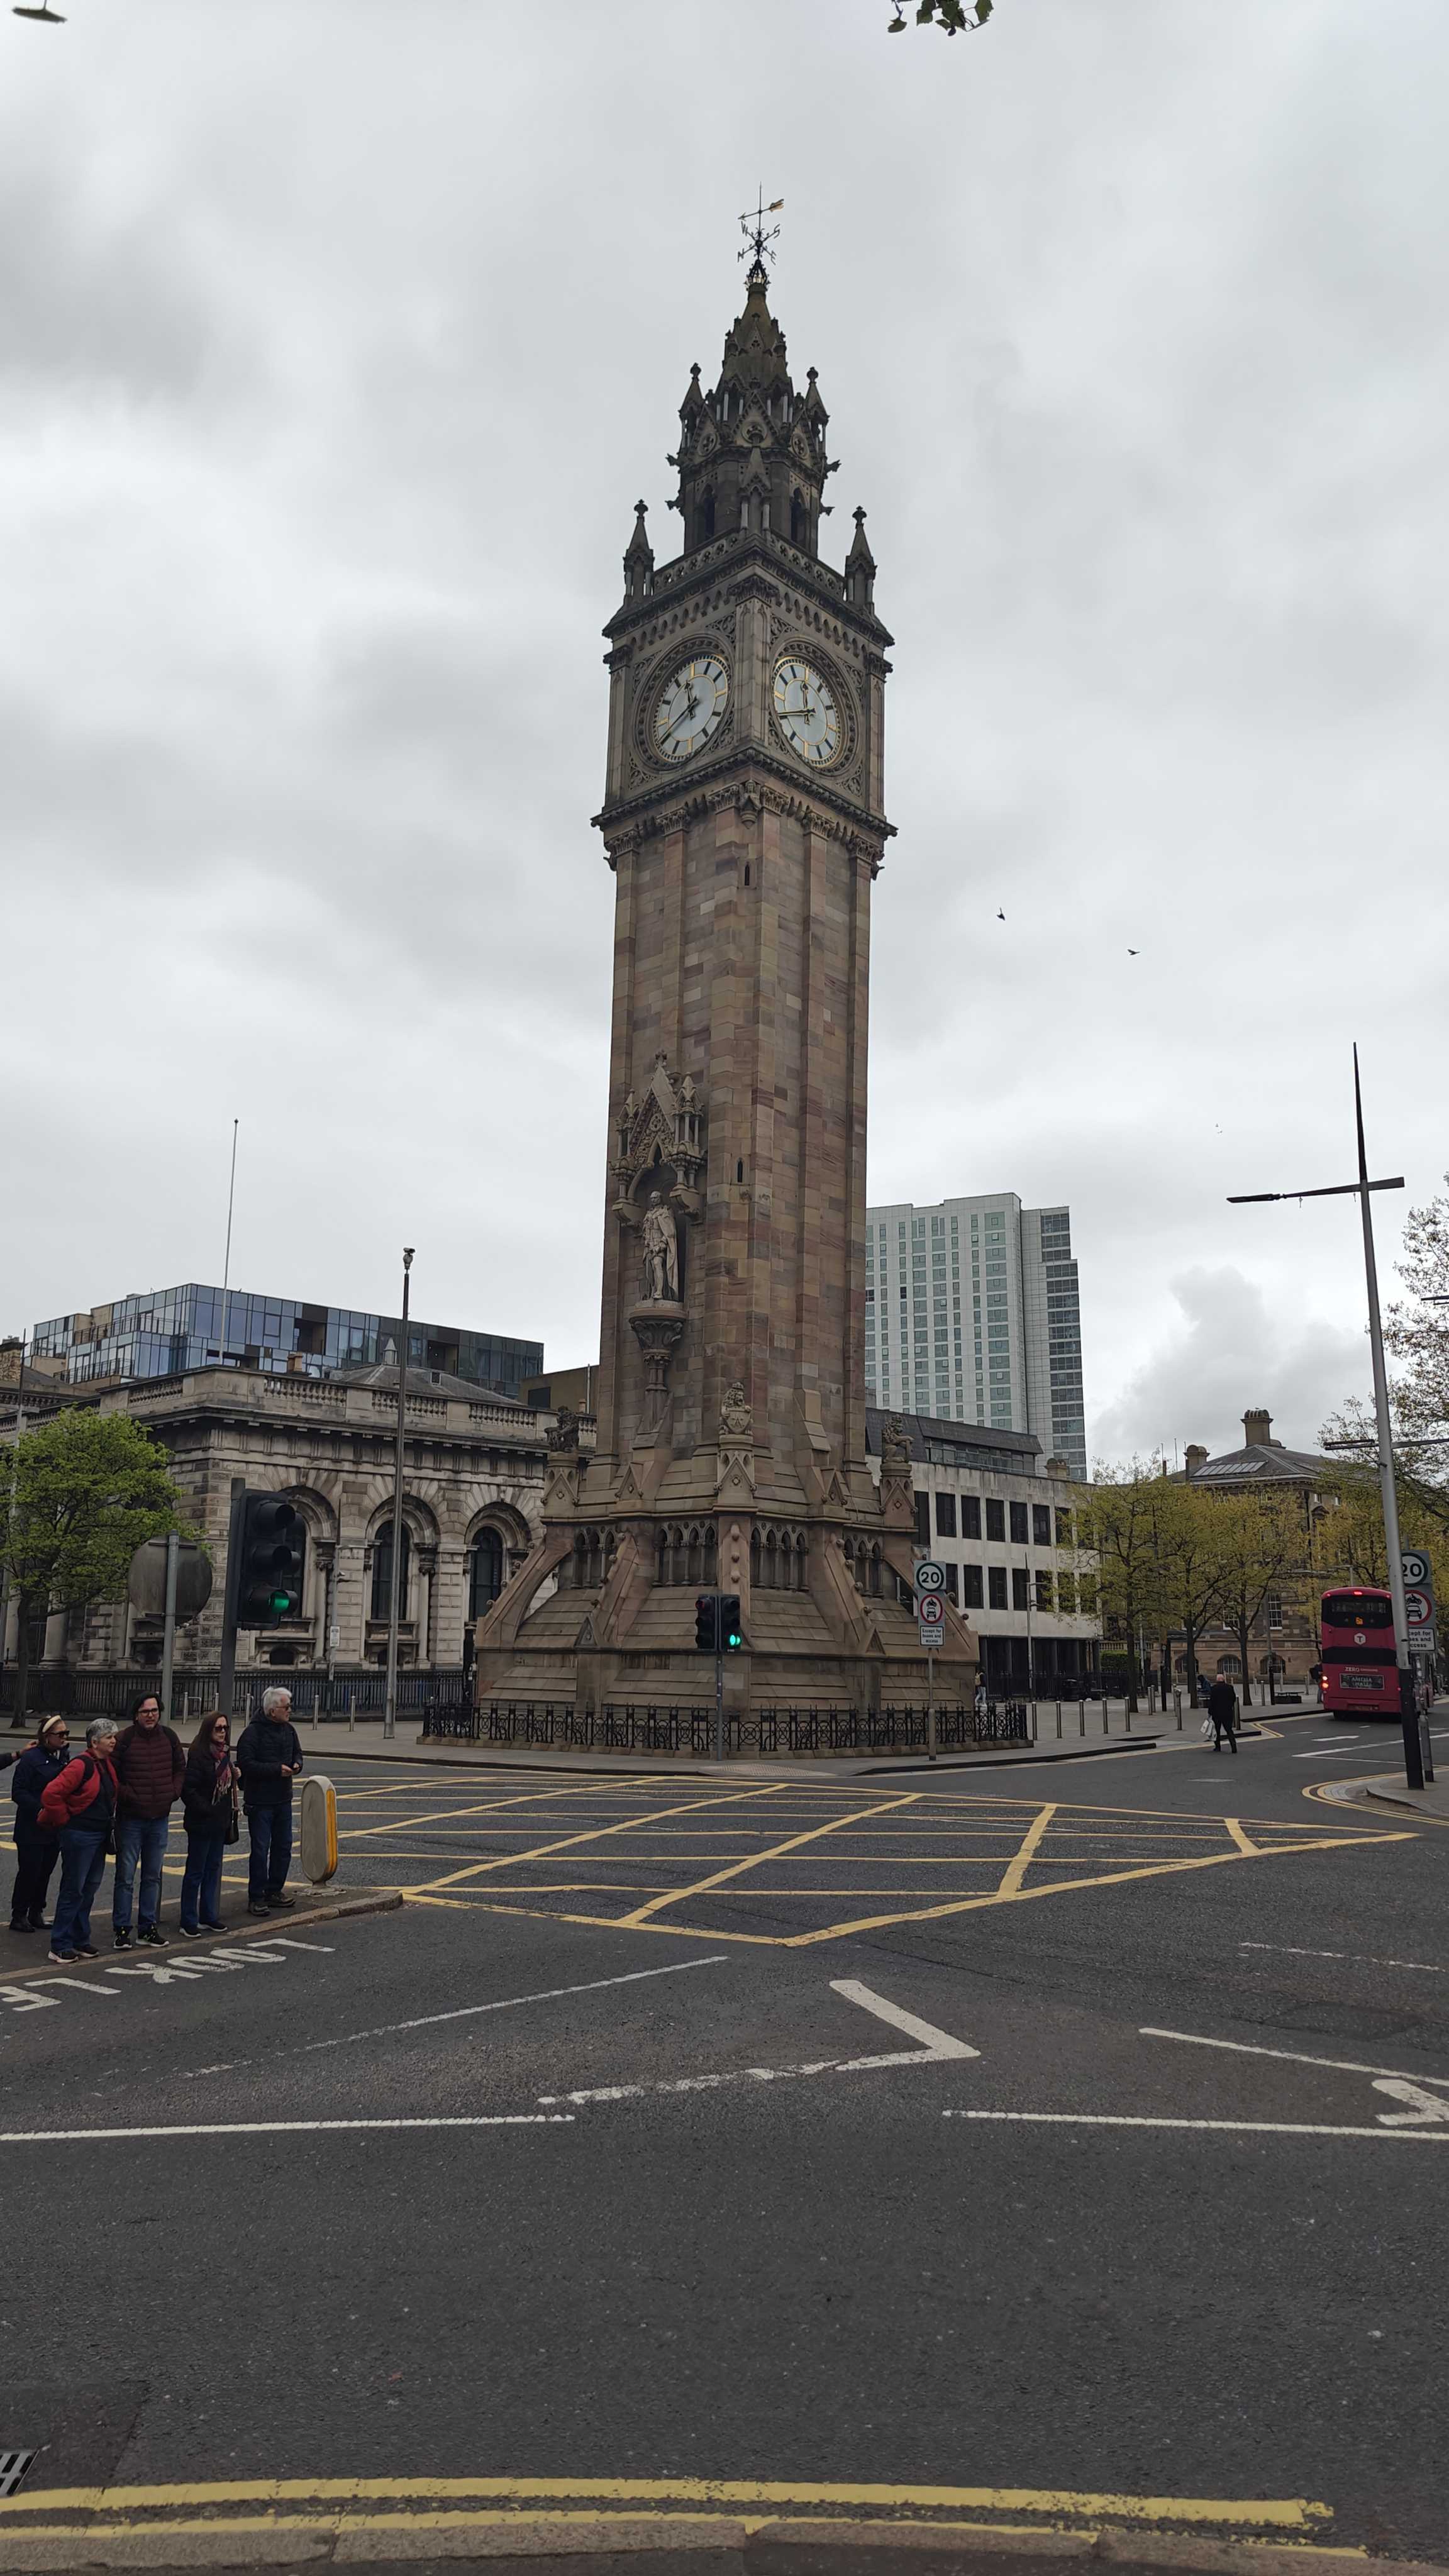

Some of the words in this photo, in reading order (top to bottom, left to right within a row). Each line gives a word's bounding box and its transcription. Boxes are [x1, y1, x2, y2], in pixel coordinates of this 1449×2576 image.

[921, 1572, 940, 1584] 20
[1402, 1563, 1421, 1577] 20
[105, 1938, 336, 1984] LOOK
[0, 1977, 121, 2012] LE
